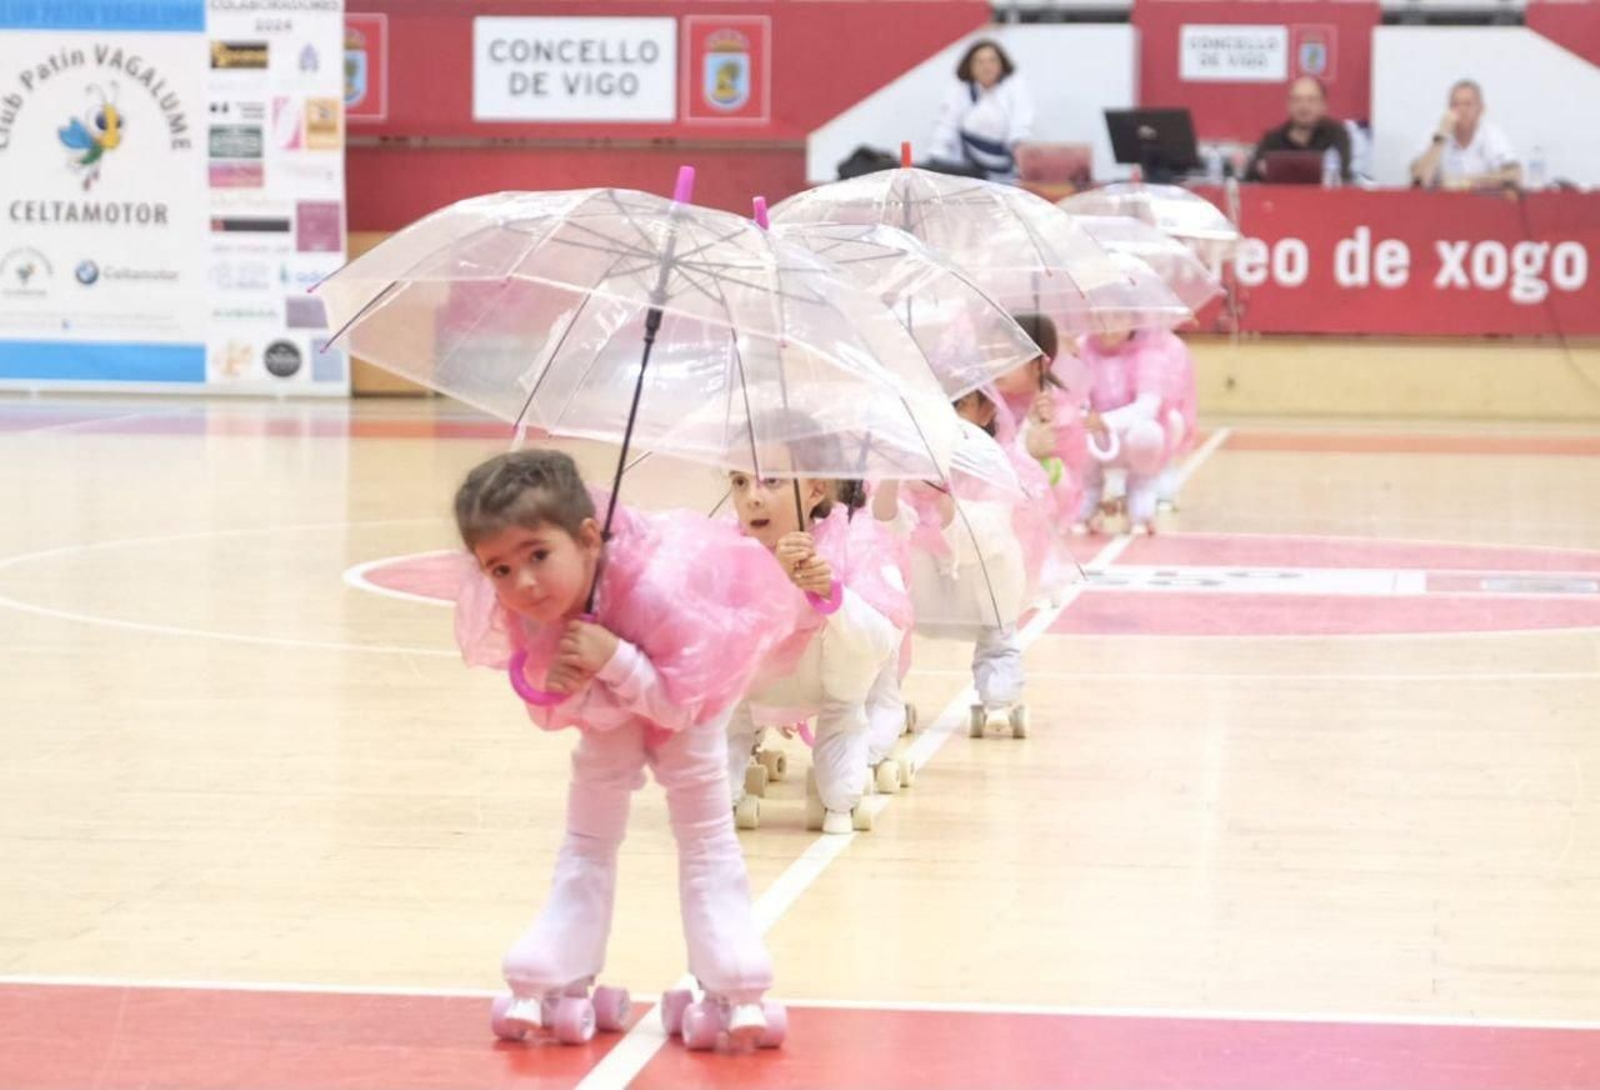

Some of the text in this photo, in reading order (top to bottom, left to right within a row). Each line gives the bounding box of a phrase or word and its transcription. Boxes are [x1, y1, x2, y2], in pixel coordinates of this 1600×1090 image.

[489, 39, 660, 65] CONCELLO
[95, 44, 192, 150] VAGALUME
[508, 71, 640, 97] DE VIGO
[9, 200, 169, 224] CELTAMOTOR
[1334, 226, 1411, 288] de
[1434, 239, 1589, 305] xogo
